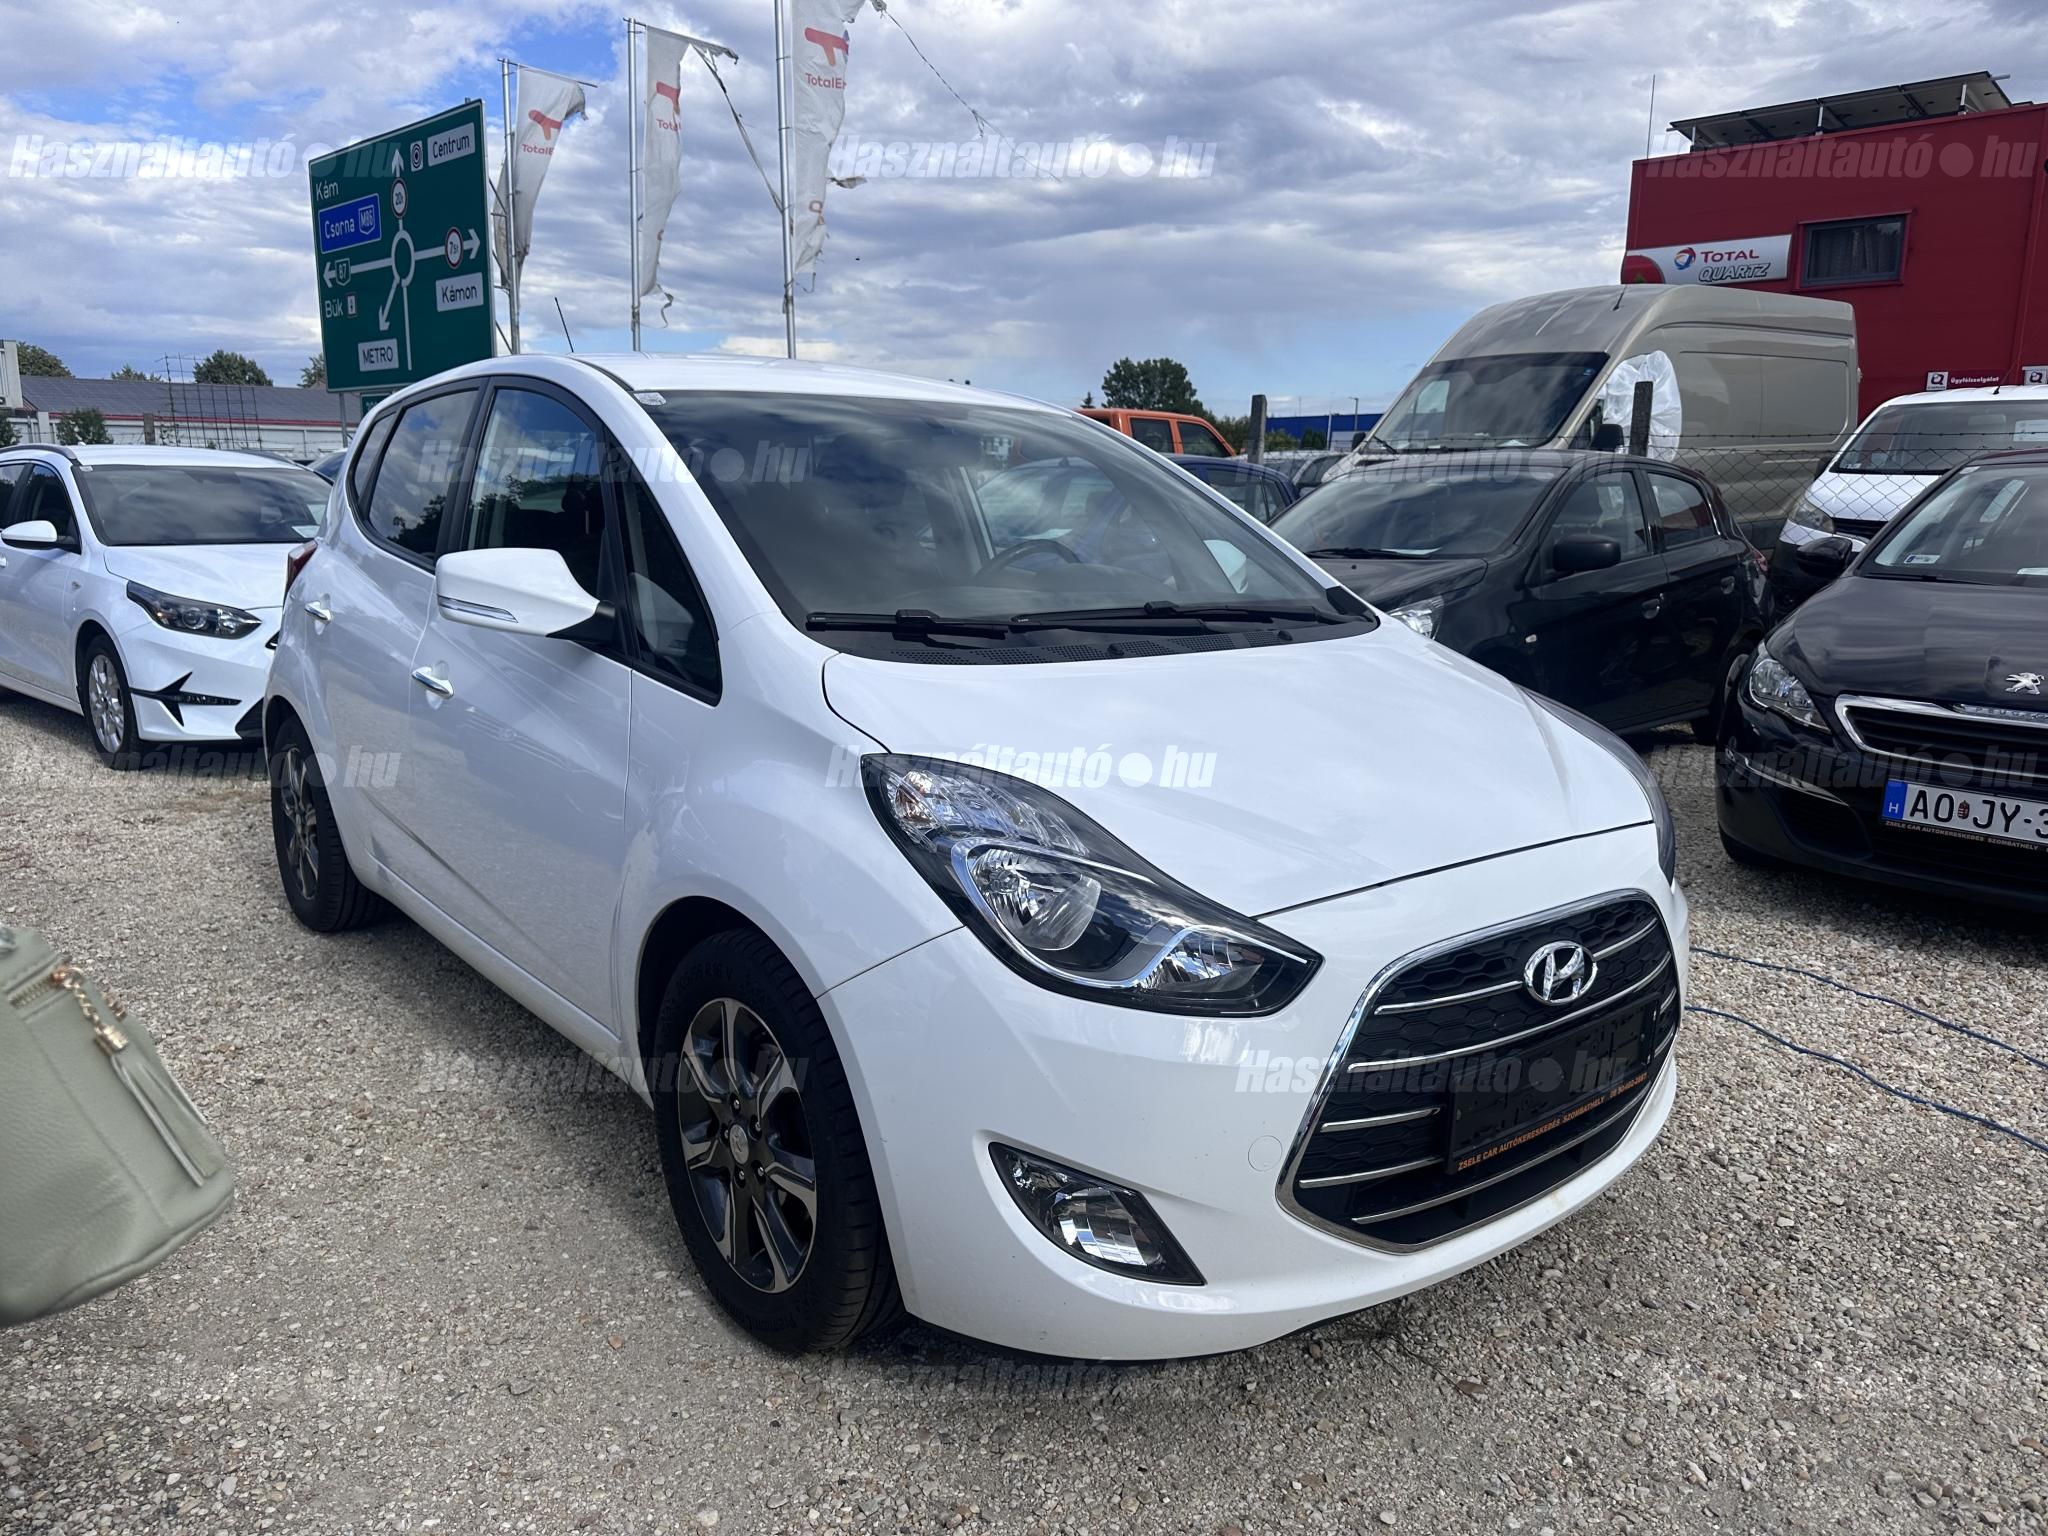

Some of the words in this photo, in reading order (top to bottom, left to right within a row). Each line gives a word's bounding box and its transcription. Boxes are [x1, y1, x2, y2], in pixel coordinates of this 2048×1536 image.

[432, 134, 470, 158] Centrum
[316, 181, 339, 201] Kám
[324, 219, 355, 239] Csorna
[1700, 249, 1760, 263] TOTAL
[1699, 262, 1771, 282] QUARTZ
[441, 284, 478, 304] Kámon
[325, 300, 344, 318] Bük
[362, 346, 394, 364] METRO
[1888, 802, 1899, 814] H
[1482, 1147, 1498, 1160] CAR
